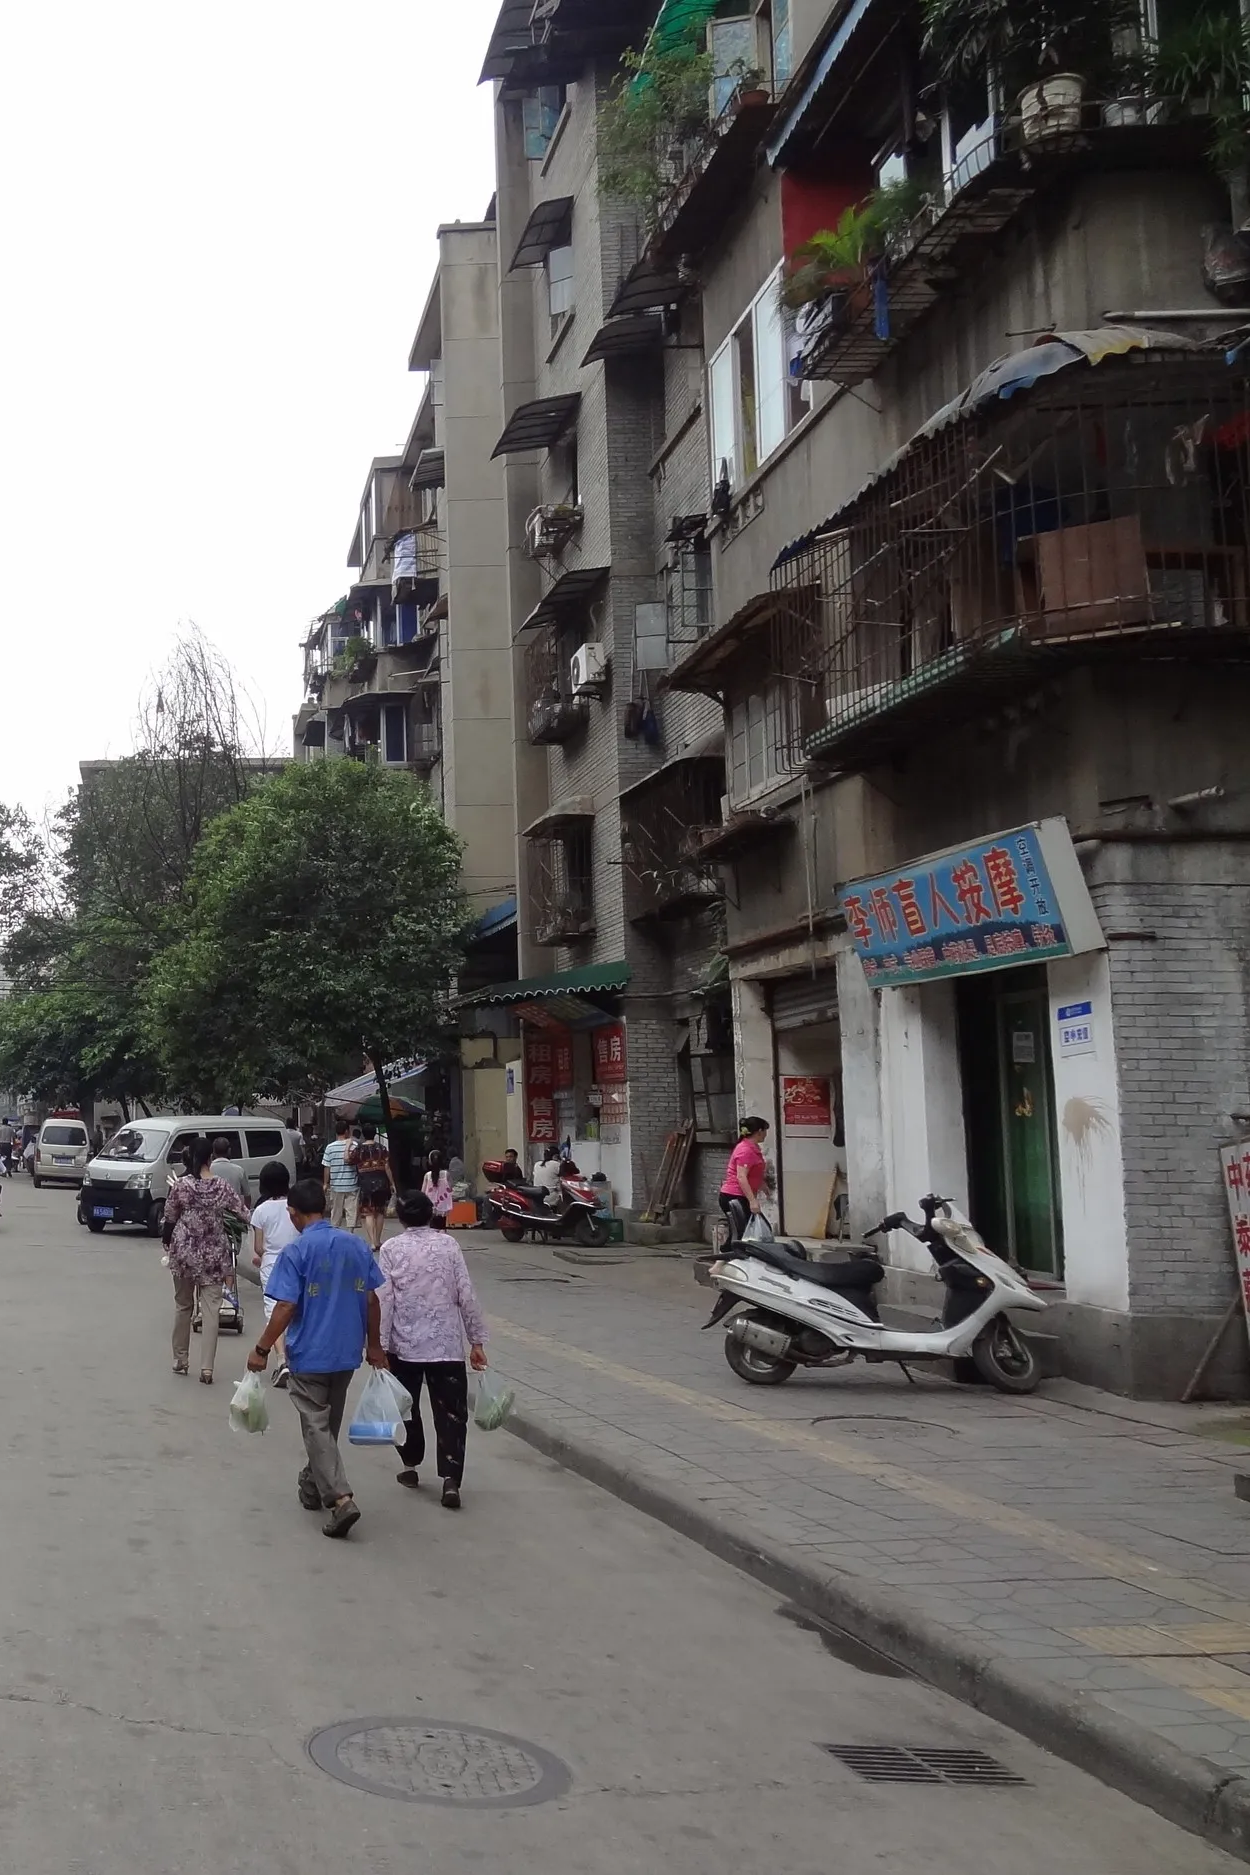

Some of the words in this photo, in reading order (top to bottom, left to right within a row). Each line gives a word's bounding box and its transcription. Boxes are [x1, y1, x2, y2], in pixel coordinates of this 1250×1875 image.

[843, 846, 1026, 949] 李师盲人按摩
[528, 1044, 552, 1084] 租房
[597, 1036, 621, 1063] 售房
[530, 1097, 554, 1138] 售房
